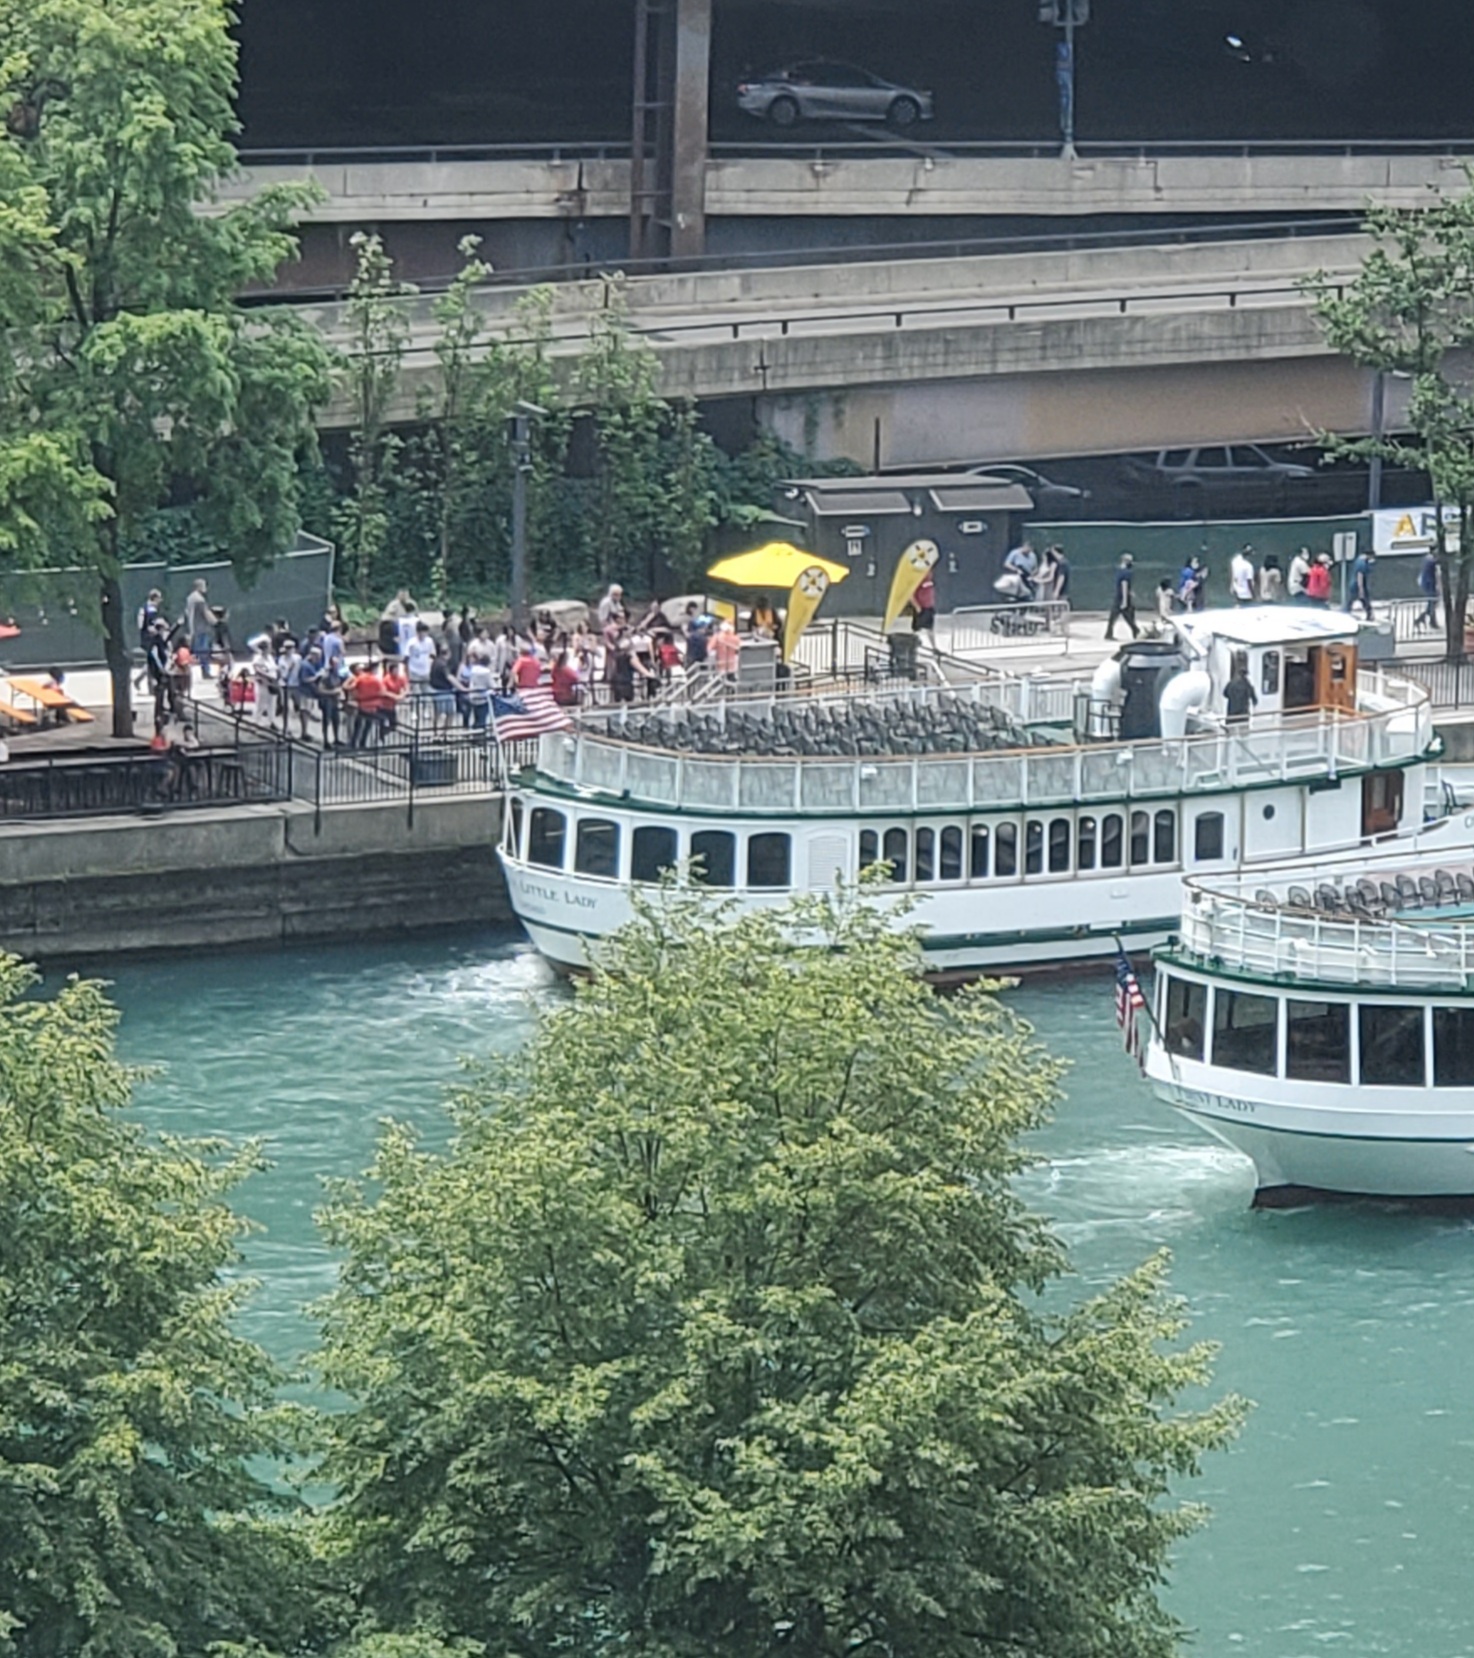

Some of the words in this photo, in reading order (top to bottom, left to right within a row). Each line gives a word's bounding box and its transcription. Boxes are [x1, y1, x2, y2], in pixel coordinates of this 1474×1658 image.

[519, 881, 560, 901] LITTLE
[564, 890, 597, 909] LADY
[1216, 1095, 1256, 1113] LADY
